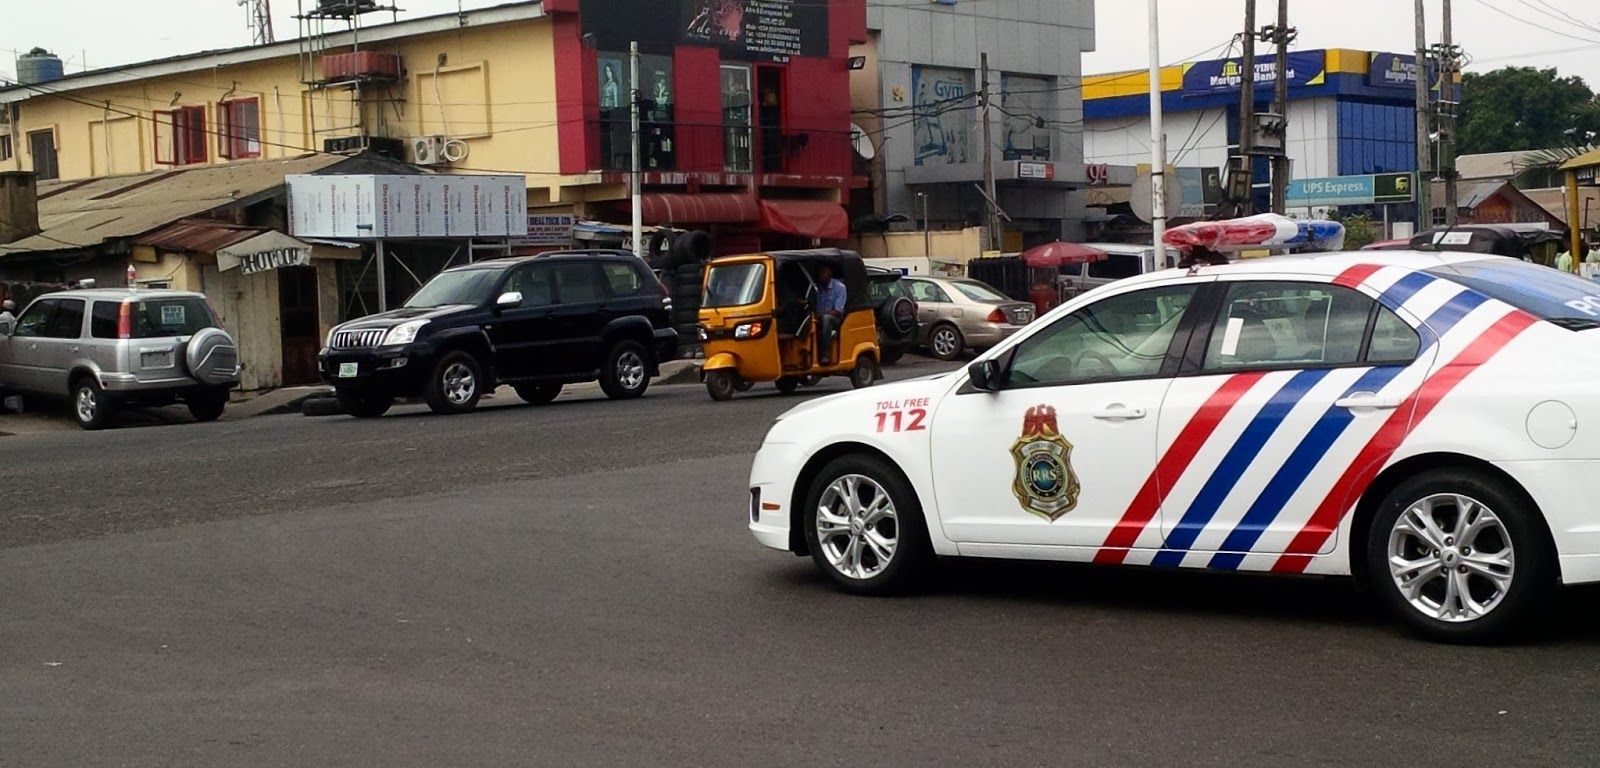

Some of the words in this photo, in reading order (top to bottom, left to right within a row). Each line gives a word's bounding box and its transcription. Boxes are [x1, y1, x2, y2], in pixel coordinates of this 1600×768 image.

[1087, 164, 1108, 185] 94
[1303, 183, 1322, 194] UPS
[1325, 181, 1364, 195] Express
[876, 400, 900, 410] TOLL
[903, 397, 930, 408] FREE
[874, 408, 926, 433] 112
[1033, 469, 1057, 481] RRS
